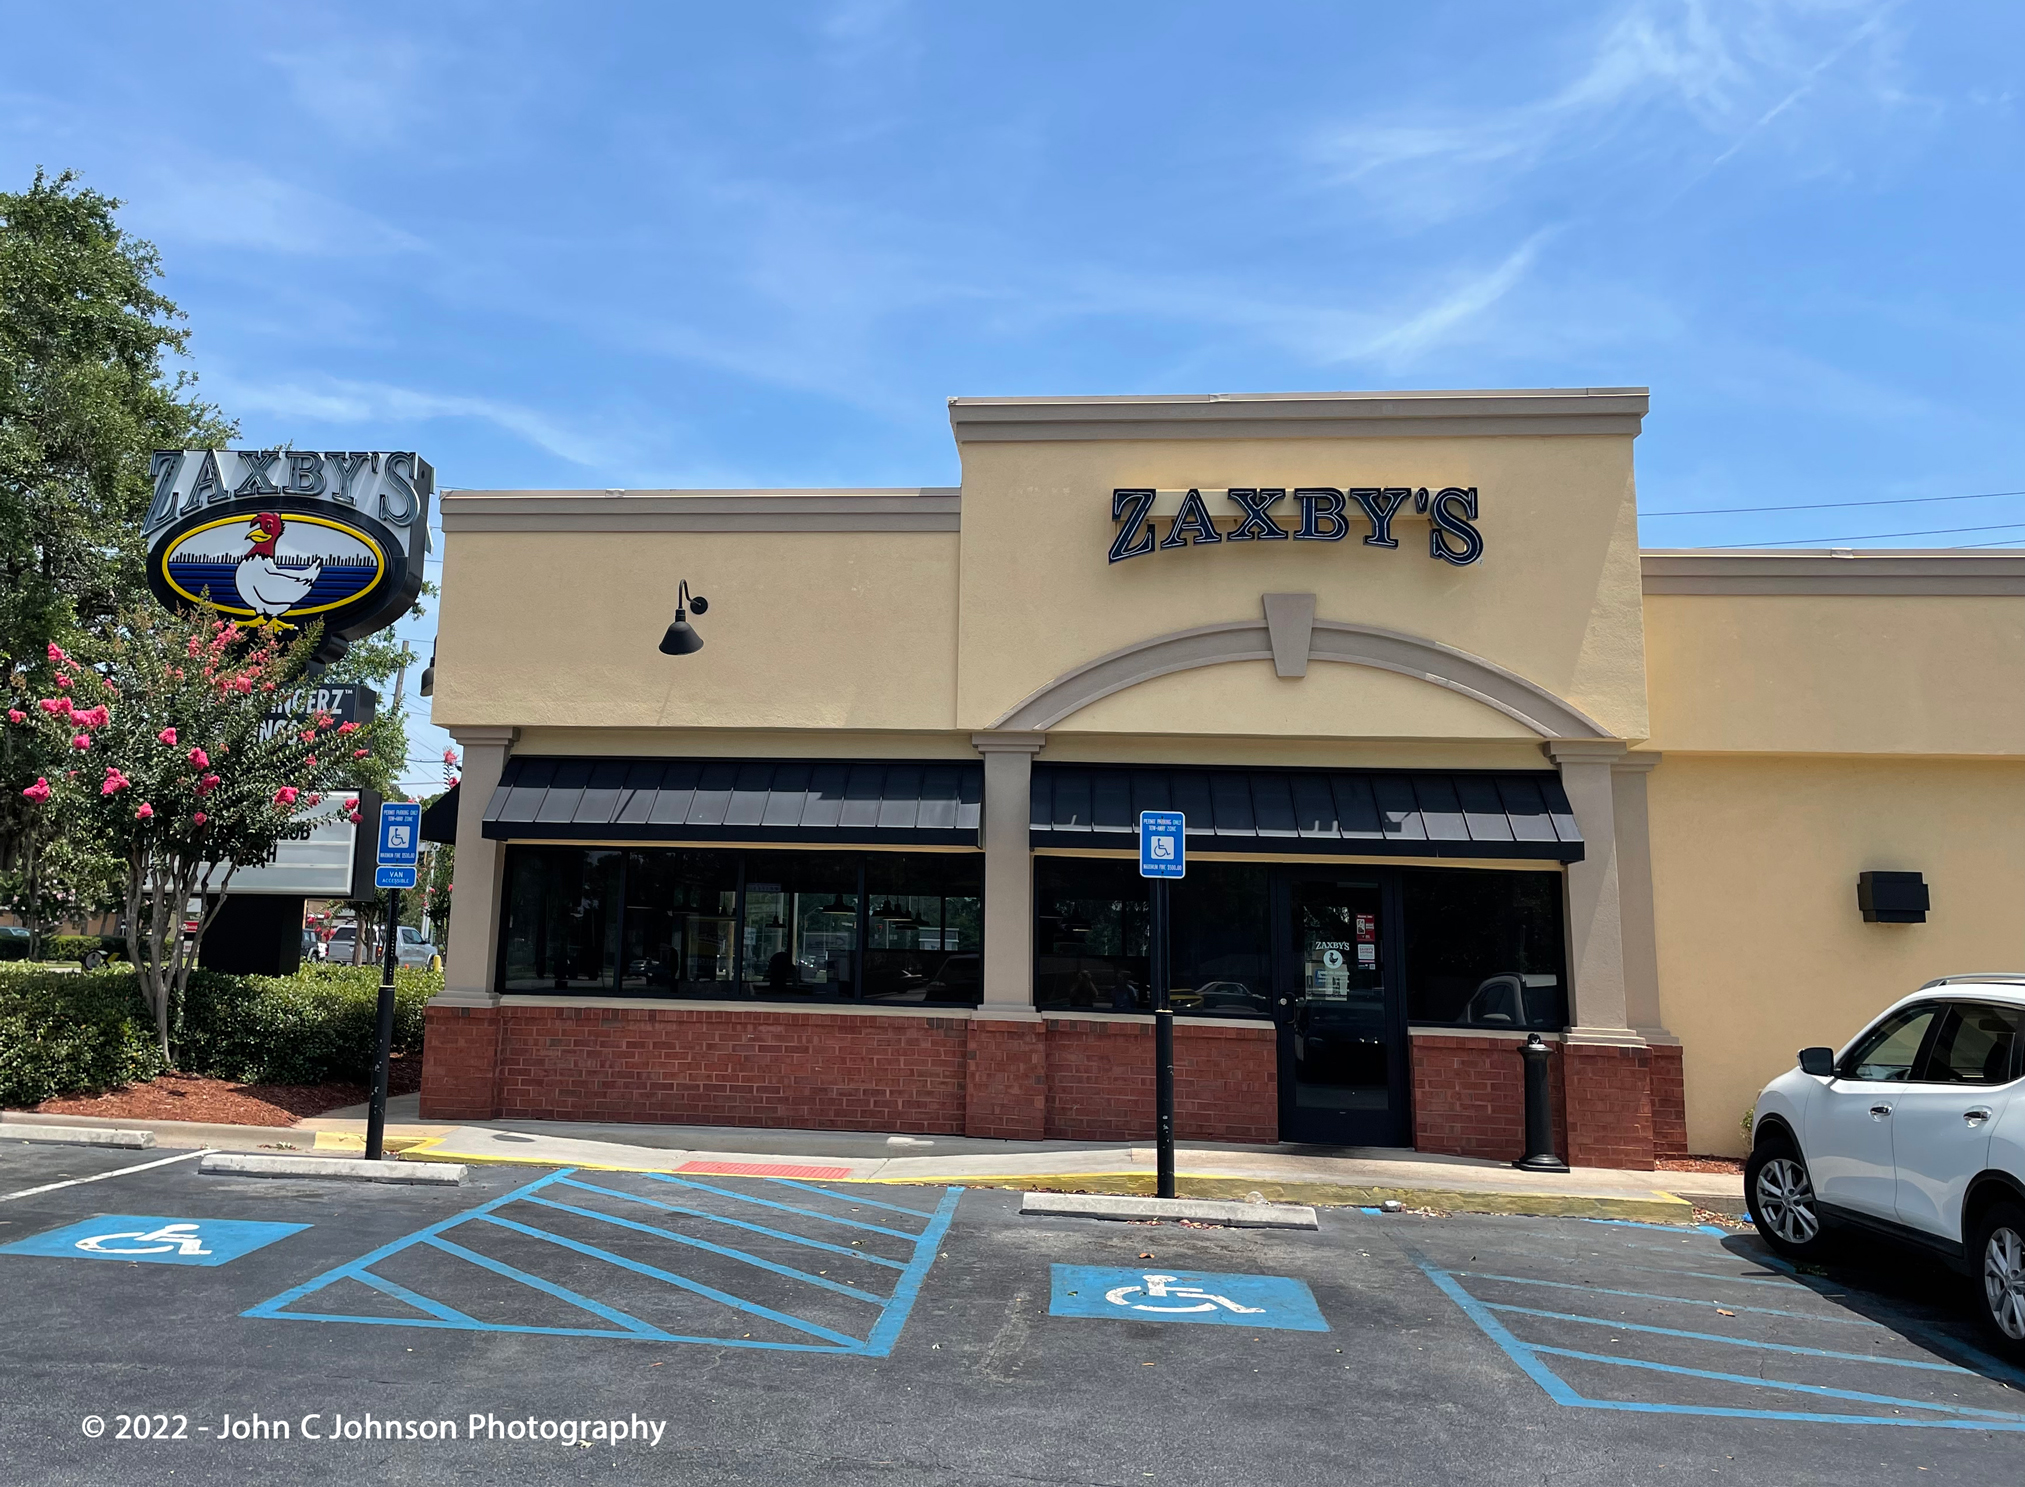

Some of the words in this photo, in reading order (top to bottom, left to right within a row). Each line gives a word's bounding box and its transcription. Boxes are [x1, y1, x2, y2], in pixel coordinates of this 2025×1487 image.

[141, 450, 420, 538] ZAXBY'S
[1108, 487, 1484, 567] ZAXBY'S
[1315, 941, 1350, 951] ZAXBY'S
